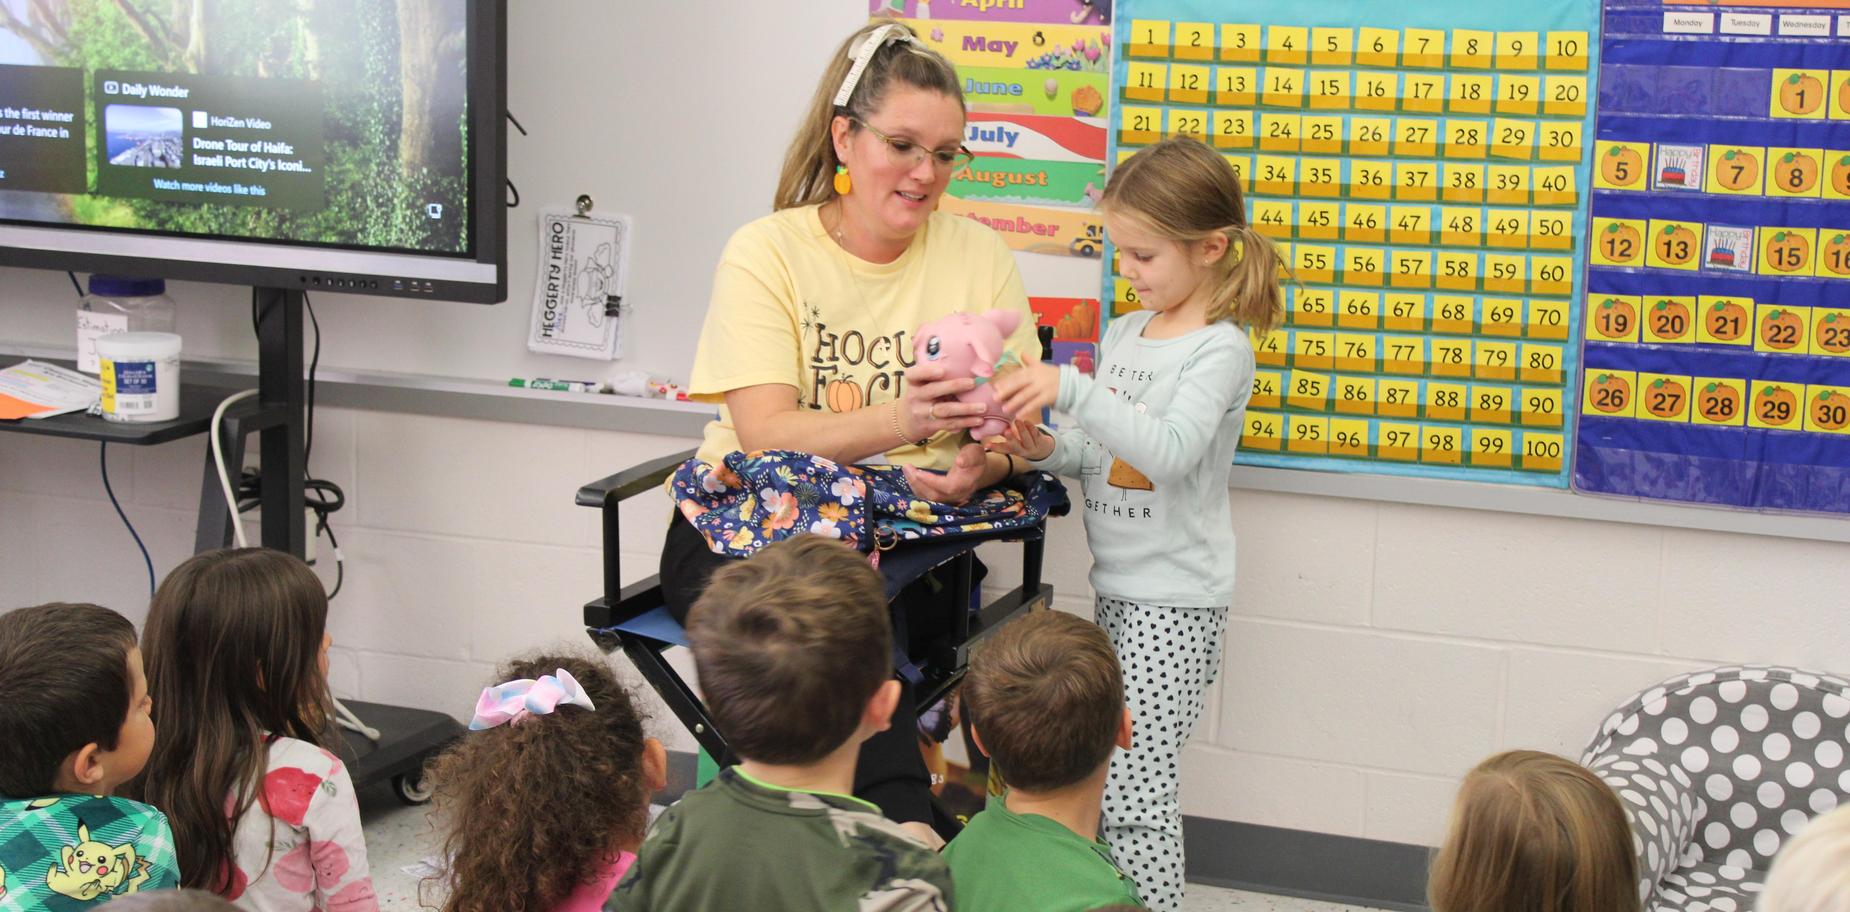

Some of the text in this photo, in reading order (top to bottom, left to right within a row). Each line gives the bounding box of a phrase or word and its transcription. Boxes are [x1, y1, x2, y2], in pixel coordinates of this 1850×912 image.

[1673, 18, 1826, 30] Monday Tuesday Wednesday
[962, 36, 1018, 57] May
[1147, 28, 1578, 57] 1 2 3 4 5 6 7 8 9 10
[122, 82, 190, 98] Daily Wonder
[964, 79, 1023, 96] June
[1139, 71, 1579, 102] 11 12 13 14 15 16 17 18 19 20
[1797, 90, 1805, 108] 1
[4, 107, 20, 119] the
[22, 107, 41, 120] first
[41, 109, 74, 122] winner
[210, 116, 272, 130] HoriZen Video
[12, 124, 26, 136] de
[27, 124, 58, 139] France
[59, 127, 70, 139] in
[969, 126, 1019, 147] July
[1133, 114, 1574, 148] 21 22 23 24 25 26 27 28 29 30
[193, 137, 294, 155] Drone Tour of Haifa:
[1660, 147, 1693, 159] Happy
[193, 153, 224, 167] Israeli
[225, 155, 248, 169] Port
[249, 157, 276, 173] City's
[1615, 162, 1803, 188] 5 7 8
[153, 178, 266, 196] Watch more videos like this
[957, 167, 1048, 188] August
[1264, 165, 1287, 182] 34
[1310, 167, 1332, 184] 35
[1359, 169, 1383, 186] 36
[1406, 171, 1429, 187] 37
[1452, 172, 1476, 189] 38
[1497, 174, 1520, 190] 39
[1542, 174, 1567, 192] 40
[1260, 210, 1564, 237] 44 45 46 47 48 49 50
[1709, 227, 1743, 239] Happy
[1607, 238, 1632, 257] 12
[1662, 239, 1689, 260] 13
[1774, 247, 1801, 267] 15
[542, 221, 565, 338] HEGGERTY HERO
[1303, 253, 1564, 282] 55 56 57 58 59 60
[1302, 296, 1325, 314] 65
[1347, 299, 1371, 316] 66
[1393, 301, 1415, 318] 67
[1441, 303, 1465, 321] 68
[1490, 306, 1514, 324] 69
[1537, 308, 1561, 326] 70
[1602, 313, 1850, 347] 19 20 21 22 23
[810, 322, 917, 370] HOCU
[1259, 336, 1554, 370] 74 75 76 77 78 79 80
[1251, 378, 1555, 414] 84 85 86 87 88 89 90
[1597, 388, 1847, 425] 26 27 28 29 30
[1251, 420, 1560, 459] 94 95 96 97 98 99 100
